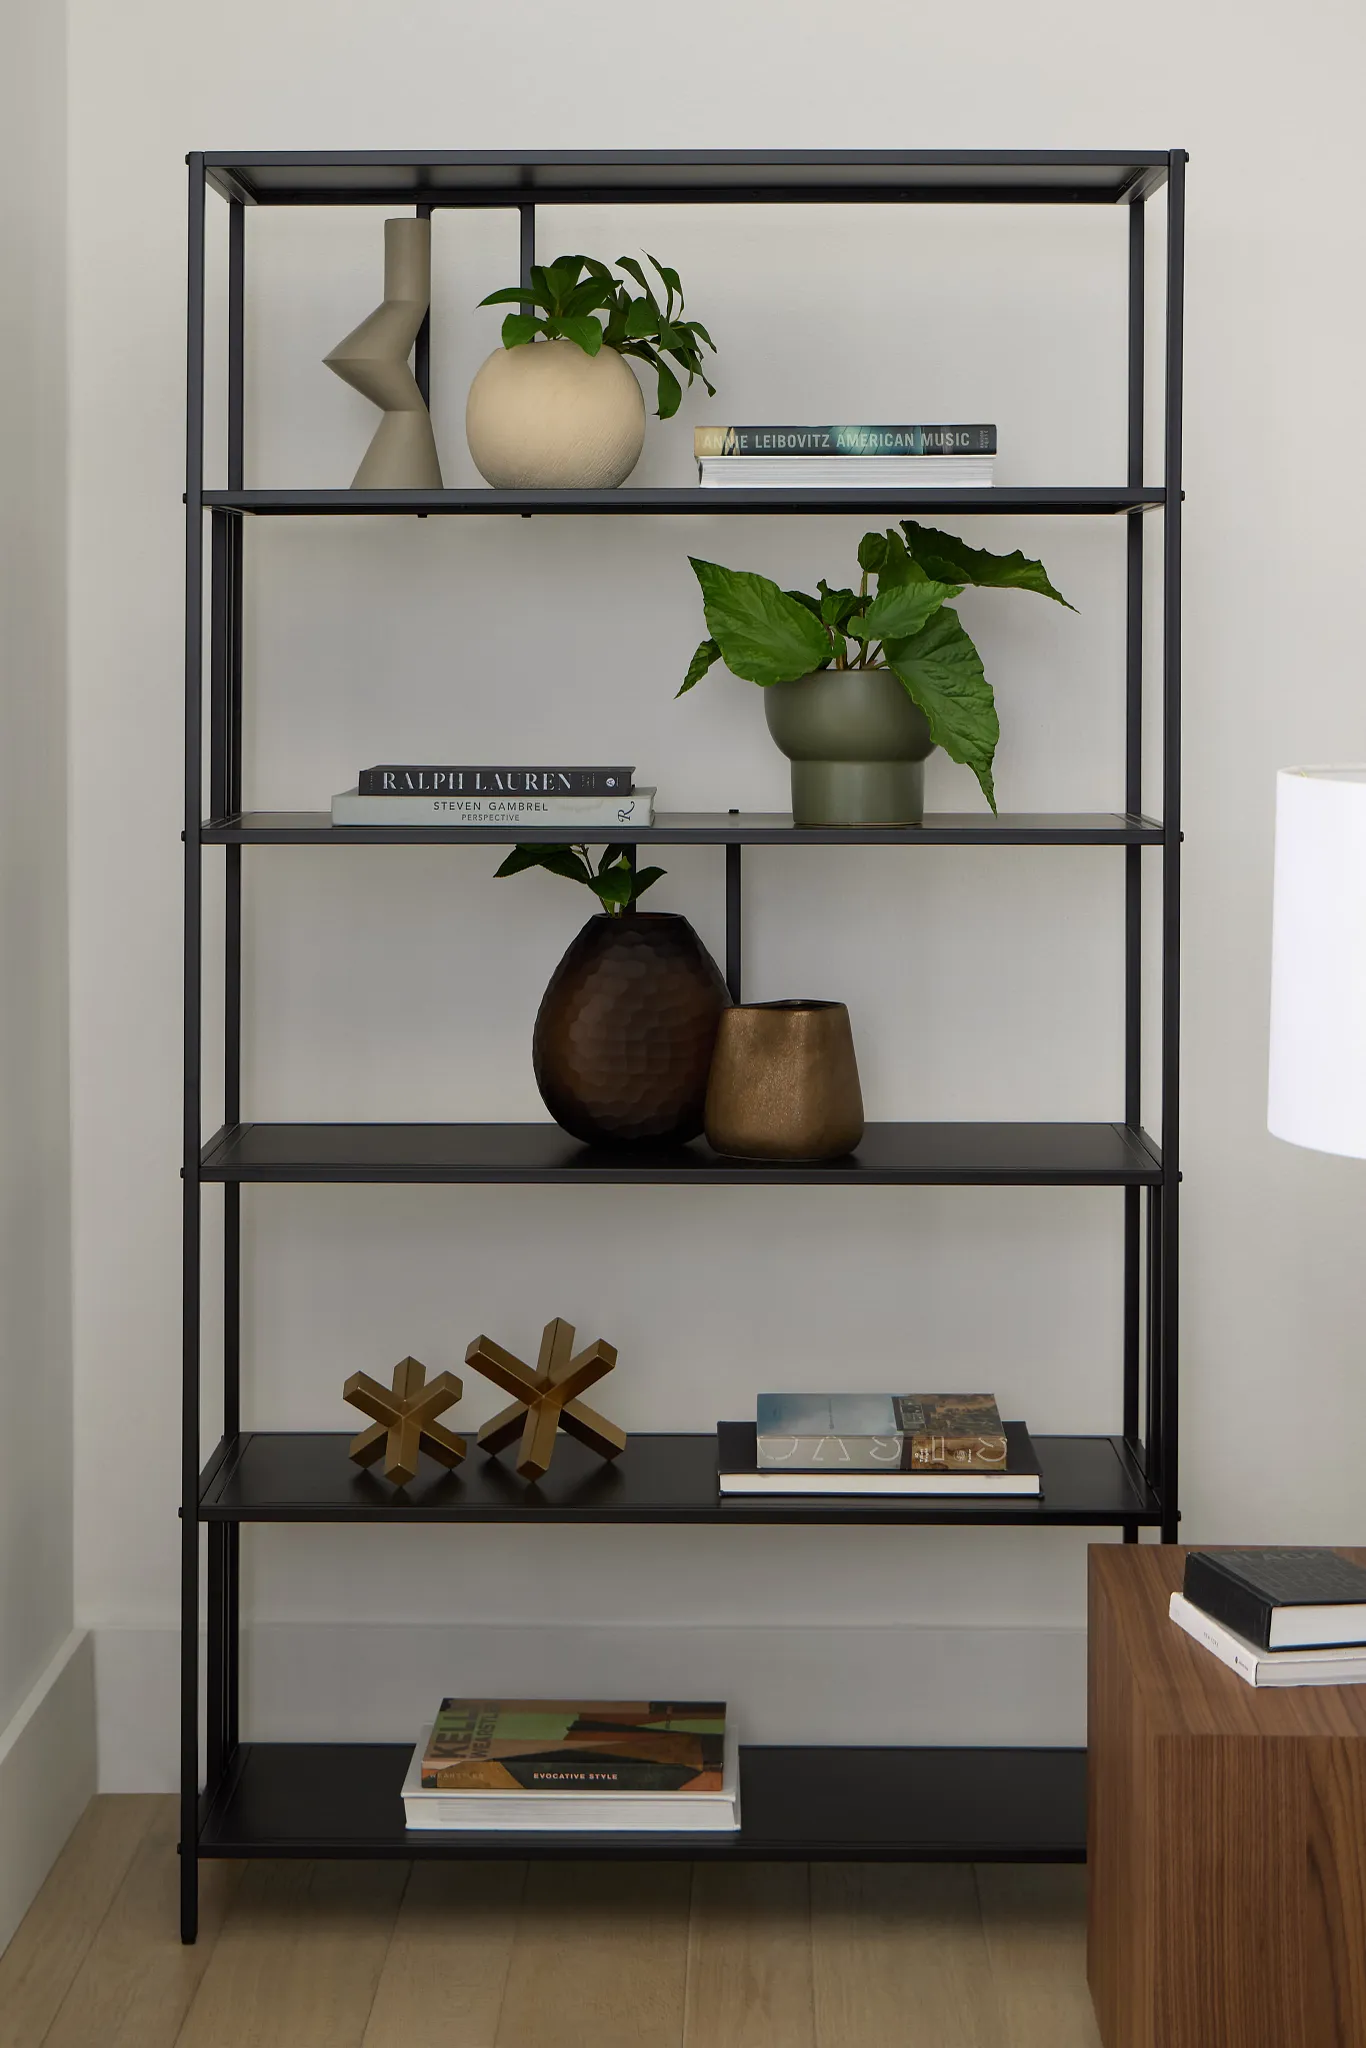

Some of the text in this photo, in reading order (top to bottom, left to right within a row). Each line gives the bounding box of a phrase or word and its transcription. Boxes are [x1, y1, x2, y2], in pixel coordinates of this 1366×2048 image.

[703, 431, 970, 449] ANNIE LEIBOVITZ AMERICAN MUSIC
[383, 772, 464, 790] RALPH
[475, 772, 572, 791] LAUREN
[433, 801, 549, 812] STEVEN GAMBREL
[461, 814, 520, 822] PERSPECTIVE
[533, 1772, 586, 1780] EVOCATIVE
[589, 1772, 618, 1780] STYLE
